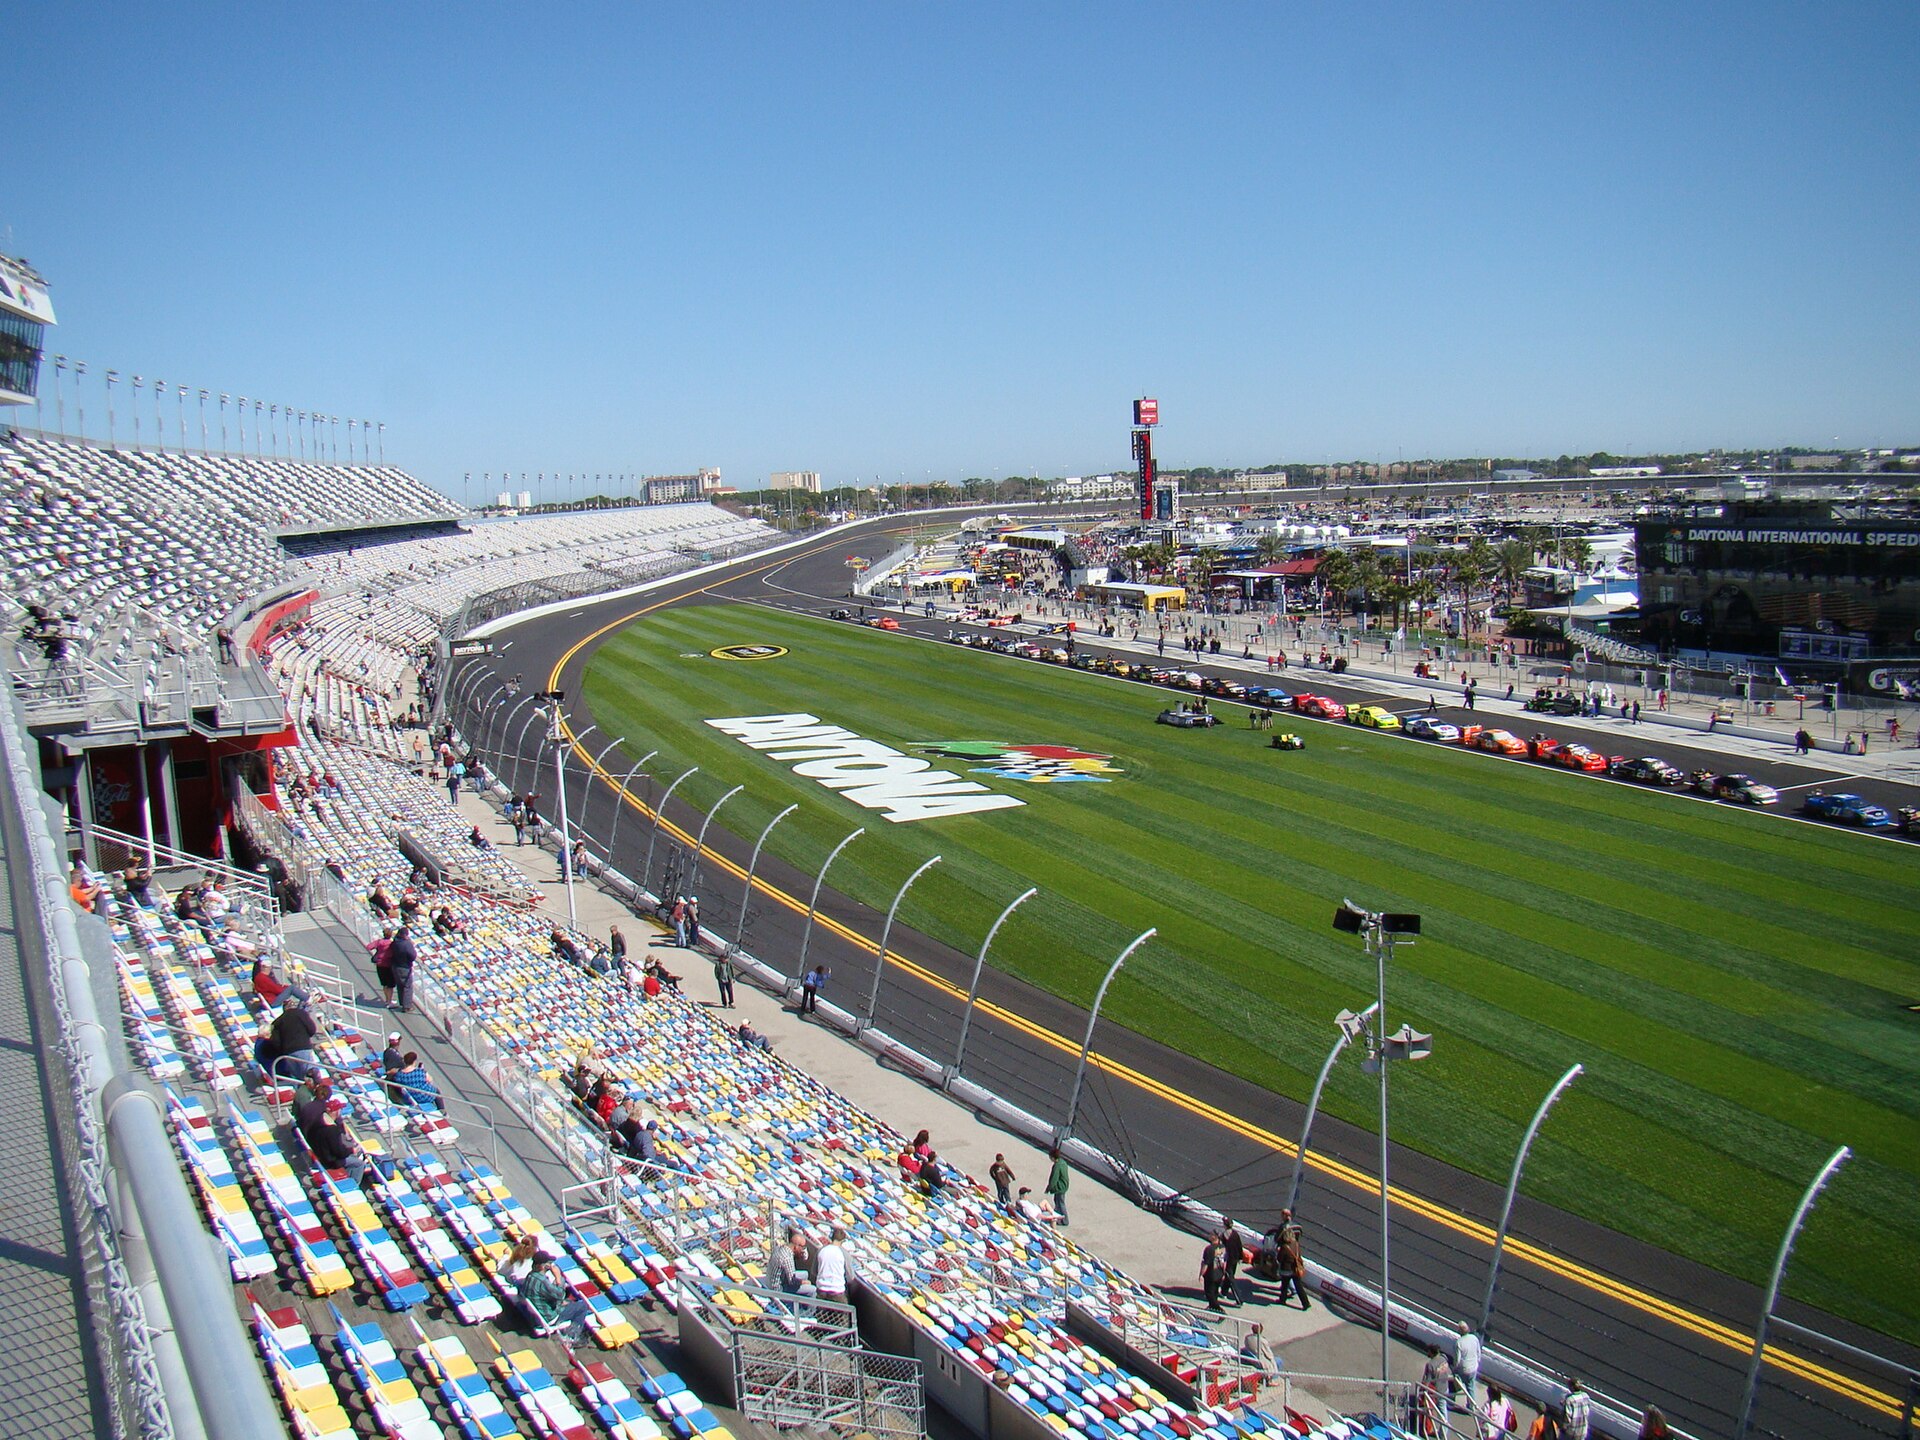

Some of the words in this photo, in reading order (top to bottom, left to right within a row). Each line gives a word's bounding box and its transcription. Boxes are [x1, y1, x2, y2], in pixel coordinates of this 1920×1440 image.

[1688, 529, 1744, 542] DAYTONA
[1747, 530, 1862, 546] INTERNATIONAL
[1865, 532, 1920, 547] SPEED
[703, 713, 1028, 823] DAYTONA
